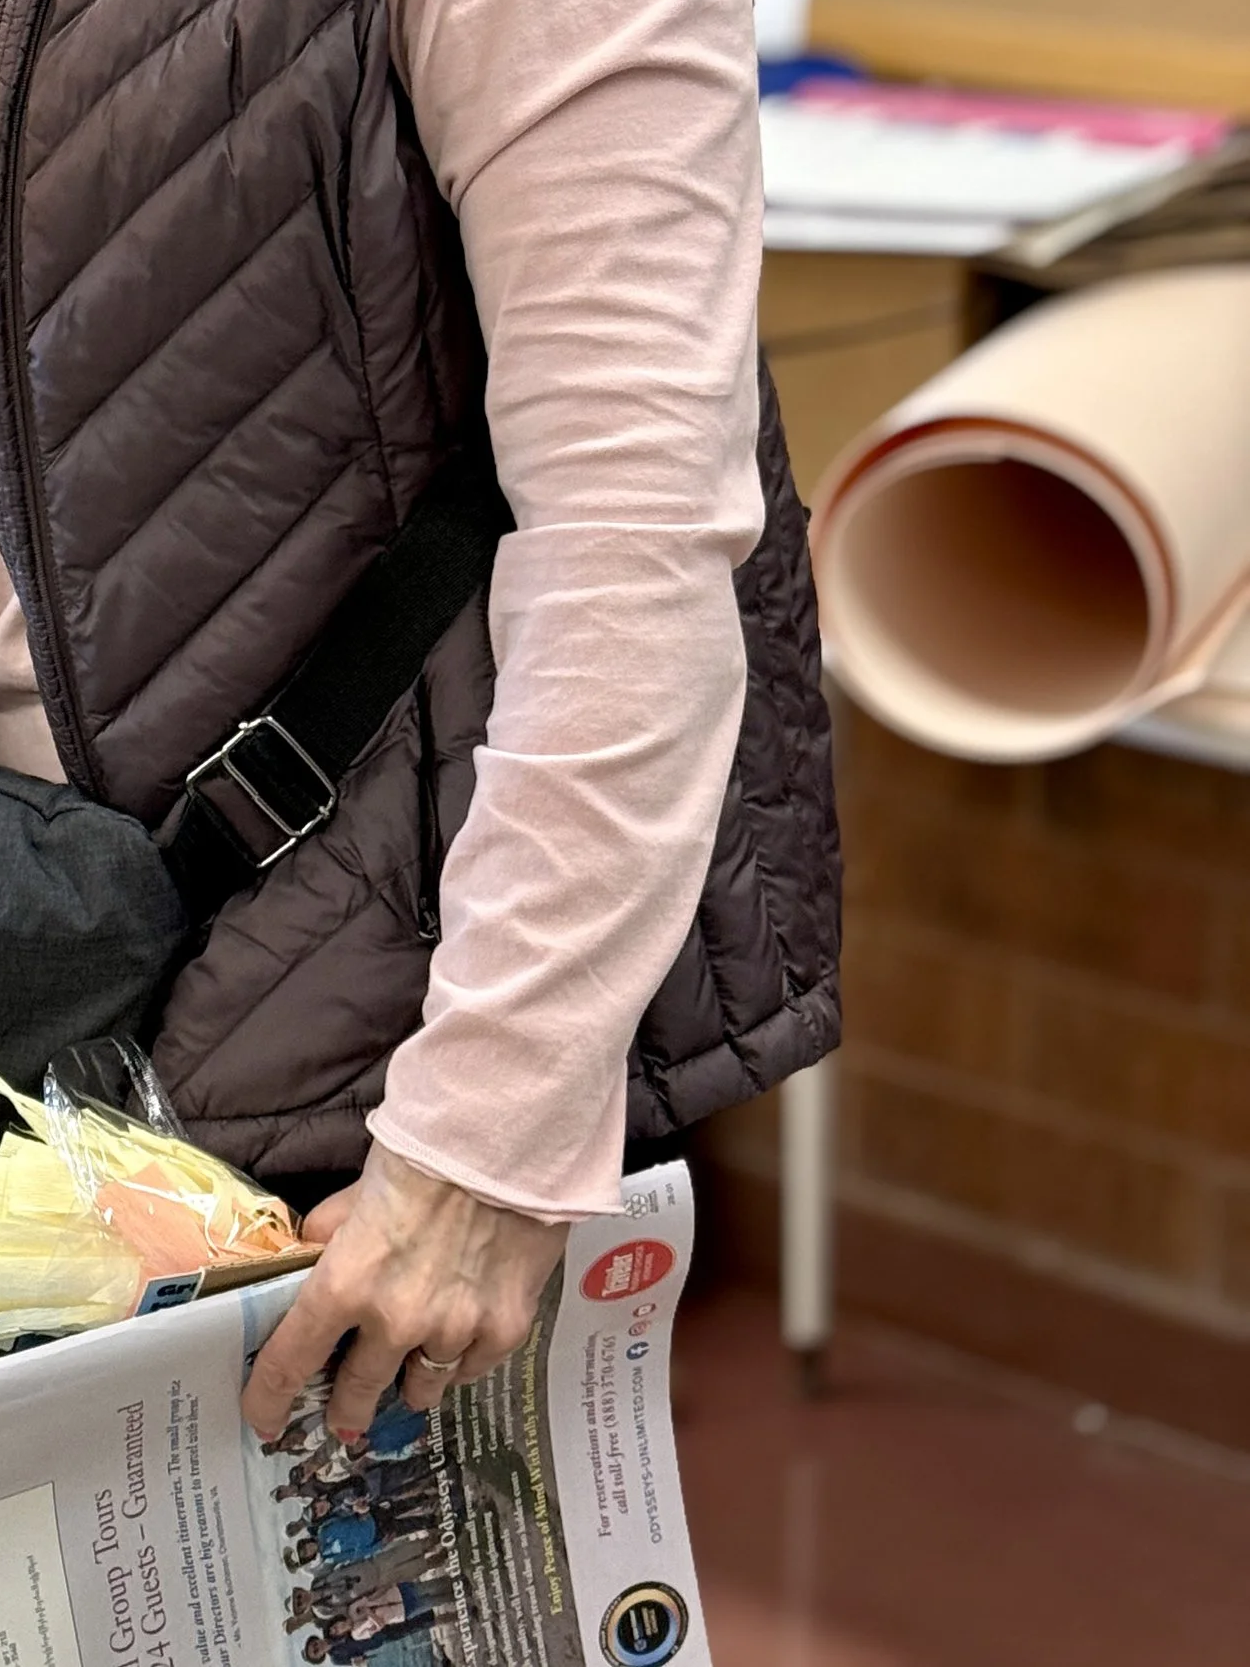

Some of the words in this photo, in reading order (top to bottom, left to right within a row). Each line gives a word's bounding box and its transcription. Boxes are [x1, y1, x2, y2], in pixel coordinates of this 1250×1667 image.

[170, 1398, 184, 1424] group
[581, 1400, 596, 1425] and
[601, 1391, 619, 1428] (888)
[166, 1425, 179, 1451] small
[524, 1415, 539, 1448] Fully
[117, 1400, 148, 1520] Guaranteed
[167, 1453, 181, 1476] The
[186, 1445, 200, 1477] travel
[588, 1428, 607, 1510] reservations
[192, 1478, 202, 1491] to
[530, 1482, 548, 1520] Mind
[612, 1489, 628, 1514] call
[171, 1477, 190, 1543] itineraries.
[194, 1493, 210, 1538] reasons
[436, 1469, 458, 1547] Odysseys
[597, 1513, 611, 1537] For
[92, 1488, 120, 1565] Tours
[465, 1520, 479, 1547] small
[537, 1520, 550, 1535] of
[199, 1539, 214, 1561] big
[445, 1549, 461, 1579] the
[543, 1537, 557, 1575] Peace
[137, 1545, 167, 1636] Guests
[182, 1545, 200, 1600] excellent
[204, 1563, 216, 1584] are
[107, 1565, 136, 1654] Group
[187, 1601, 204, 1626] and
[548, 1577, 563, 1615] Enjoy
[208, 1587, 228, 1647] Directors
[452, 1580, 478, 1667] xperience
[195, 1629, 211, 1665] value
